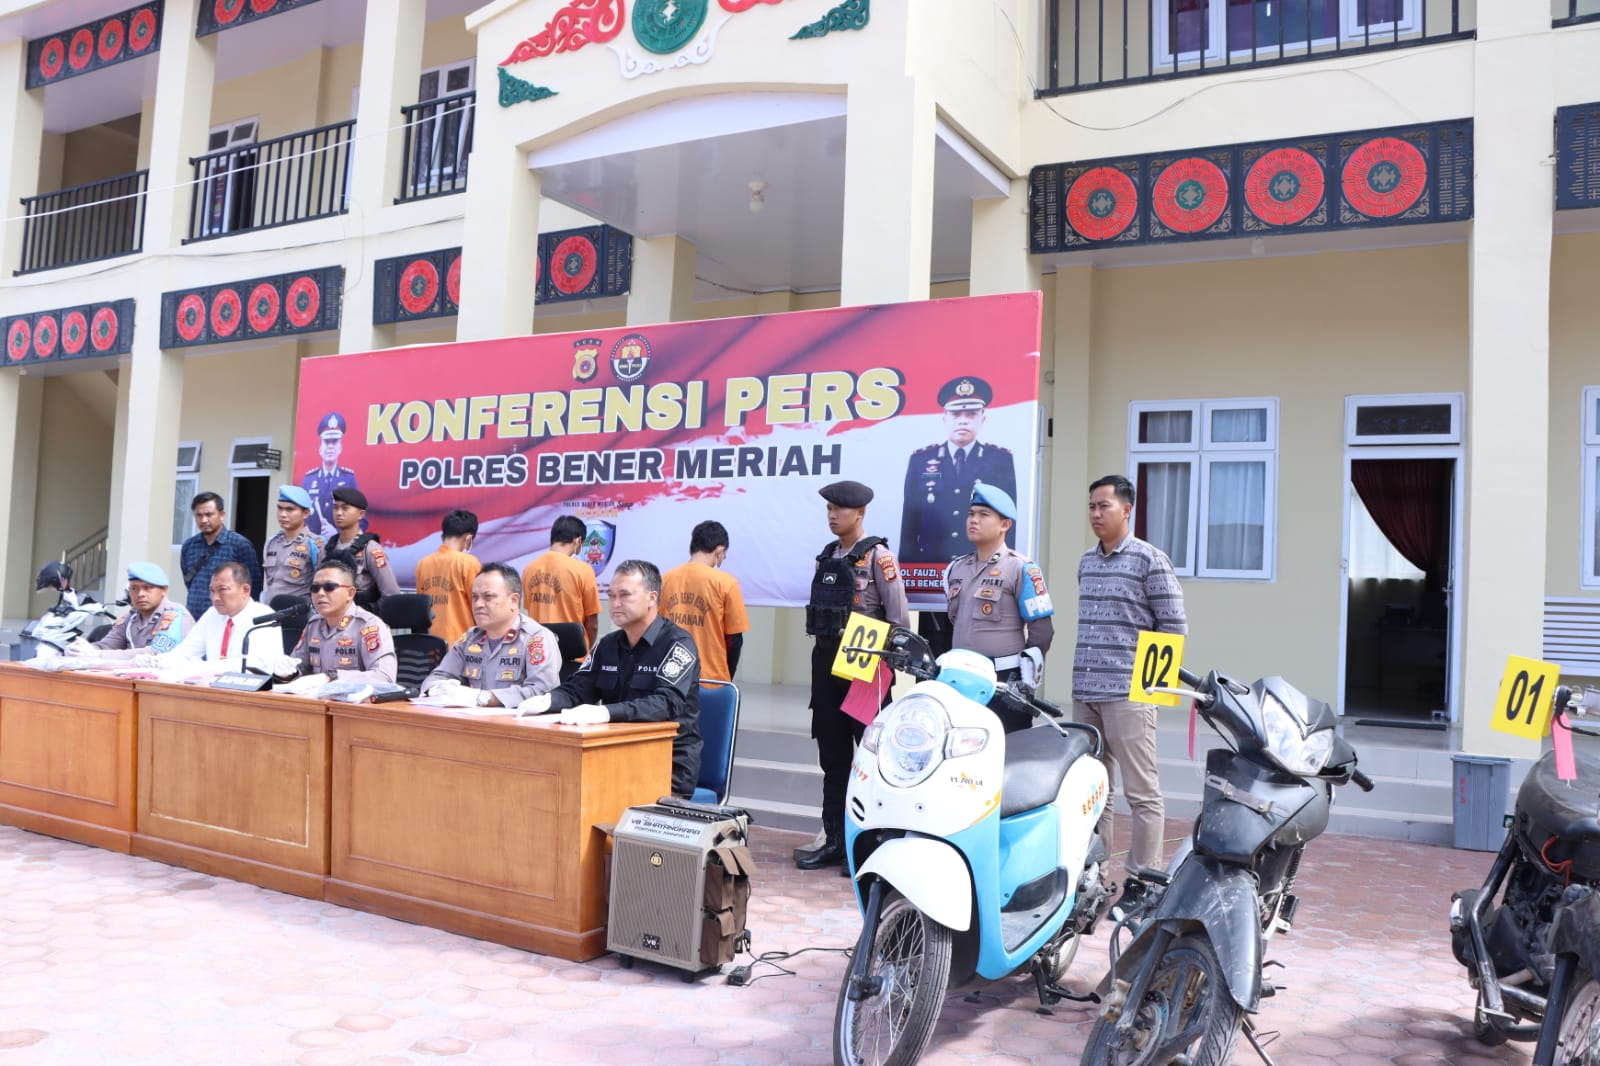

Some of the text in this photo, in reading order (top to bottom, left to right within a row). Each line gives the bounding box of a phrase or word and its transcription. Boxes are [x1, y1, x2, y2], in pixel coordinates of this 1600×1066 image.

[366, 367, 904, 445] KONFERENSI PERS
[400, 443, 842, 488] POLRES BENER MERIAH
[335, 647, 356, 655] POLRI
[500, 657, 521, 666] POLRI
[846, 625, 878, 669] 03
[1141, 643, 1173, 691] 02
[1505, 669, 1546, 726] 01
